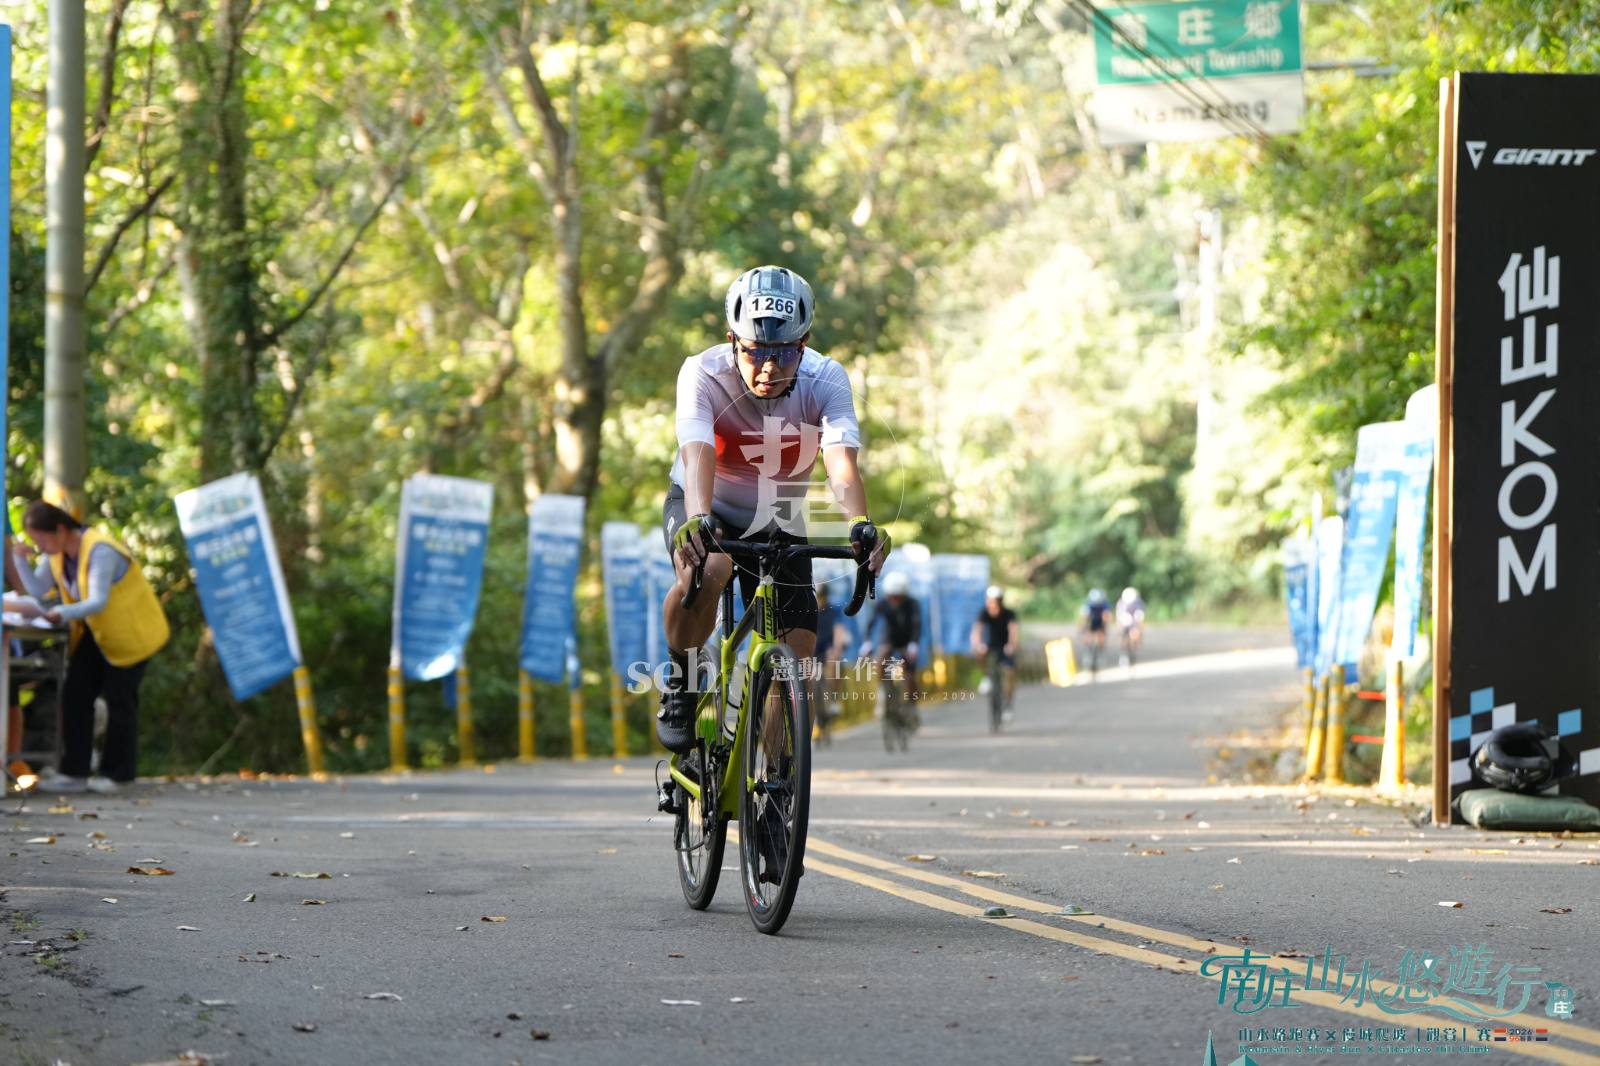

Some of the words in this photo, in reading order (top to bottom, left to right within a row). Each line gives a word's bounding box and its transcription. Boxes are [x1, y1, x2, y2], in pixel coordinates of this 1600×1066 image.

[1492, 148, 1597, 166] GIANT
[752, 297, 794, 315] 1266
[1498, 245, 1560, 386] 仙山
[1497, 388, 1558, 603] KOM
